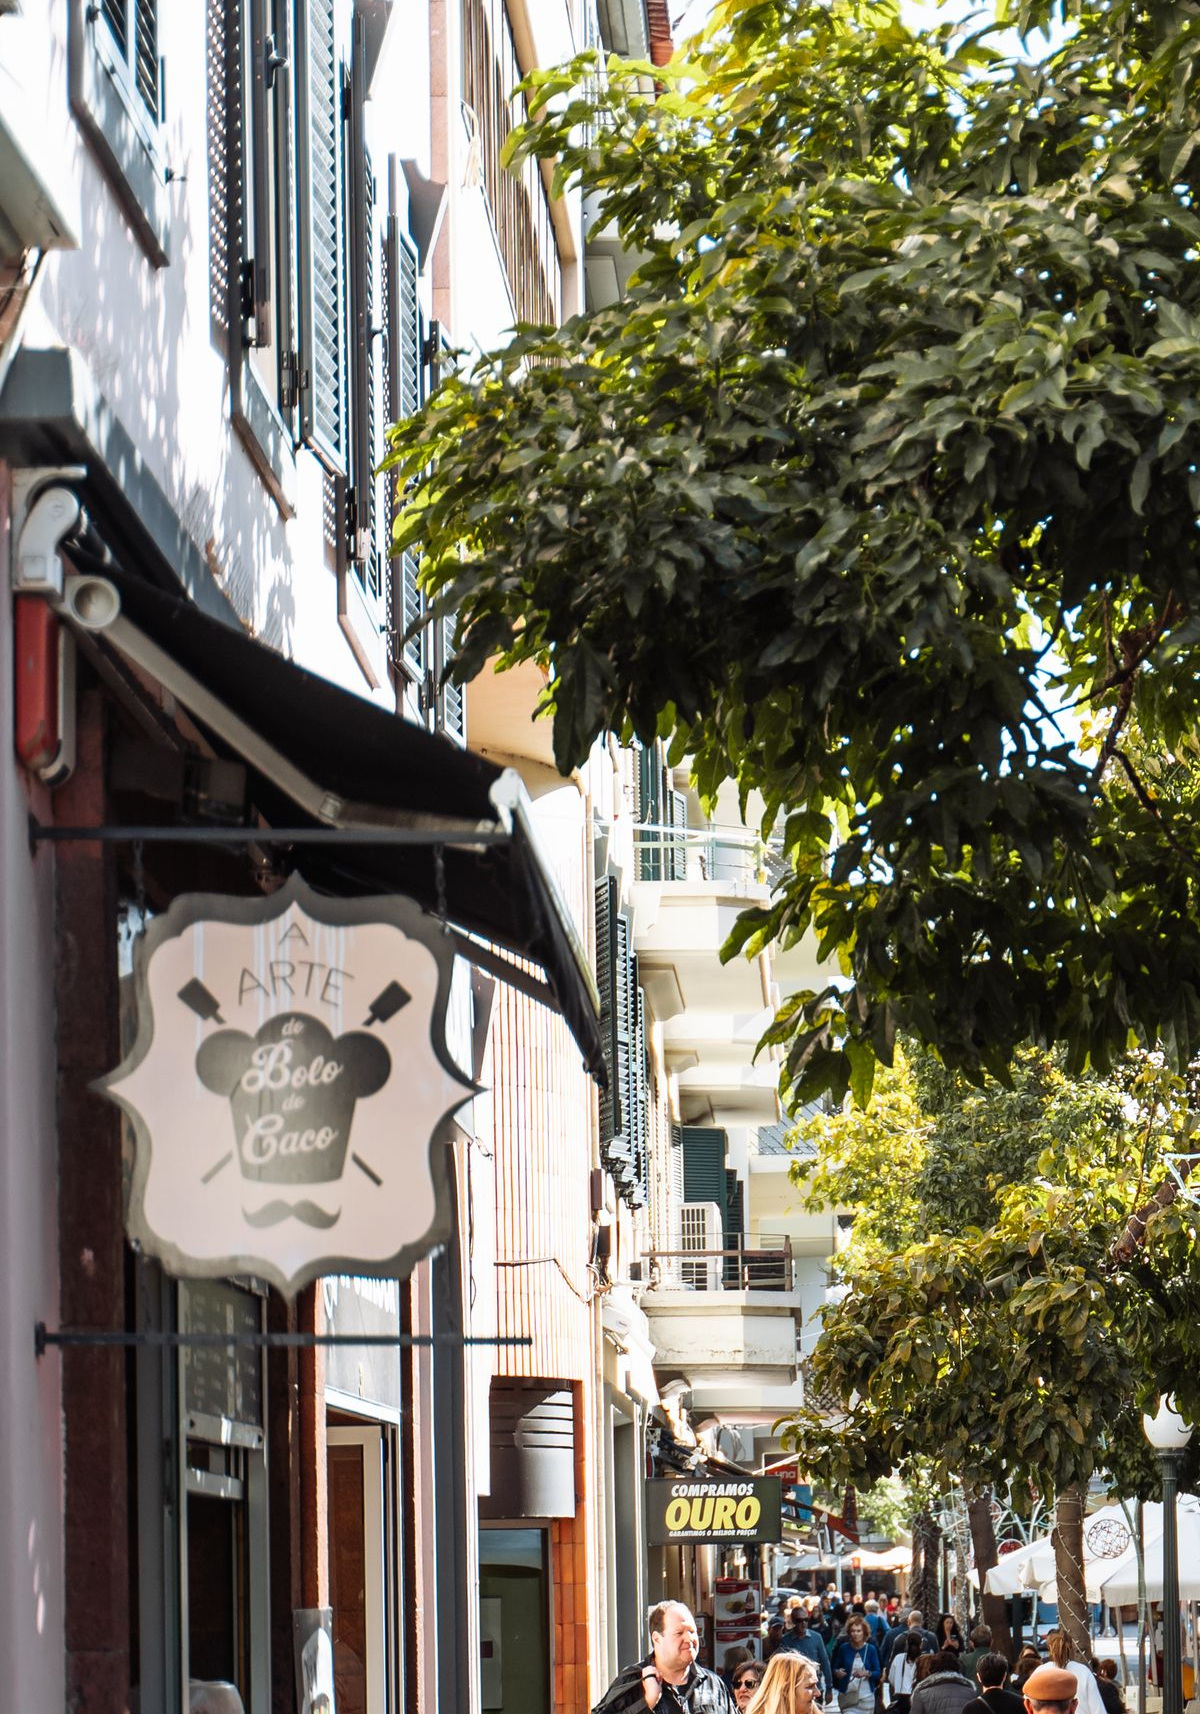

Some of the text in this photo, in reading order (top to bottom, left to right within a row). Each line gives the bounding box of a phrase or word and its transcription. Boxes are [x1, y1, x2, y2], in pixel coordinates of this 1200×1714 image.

[278, 922, 309, 946] A
[238, 961, 354, 1006] ARTE
[281, 1017, 304, 1035] de
[240, 1038, 344, 1094] Bolo
[281, 1093, 304, 1111] de
[241, 1113, 339, 1165] Caco
[671, 1483, 754, 1497] COMPRAMOS
[665, 1496, 761, 1531] OURO
